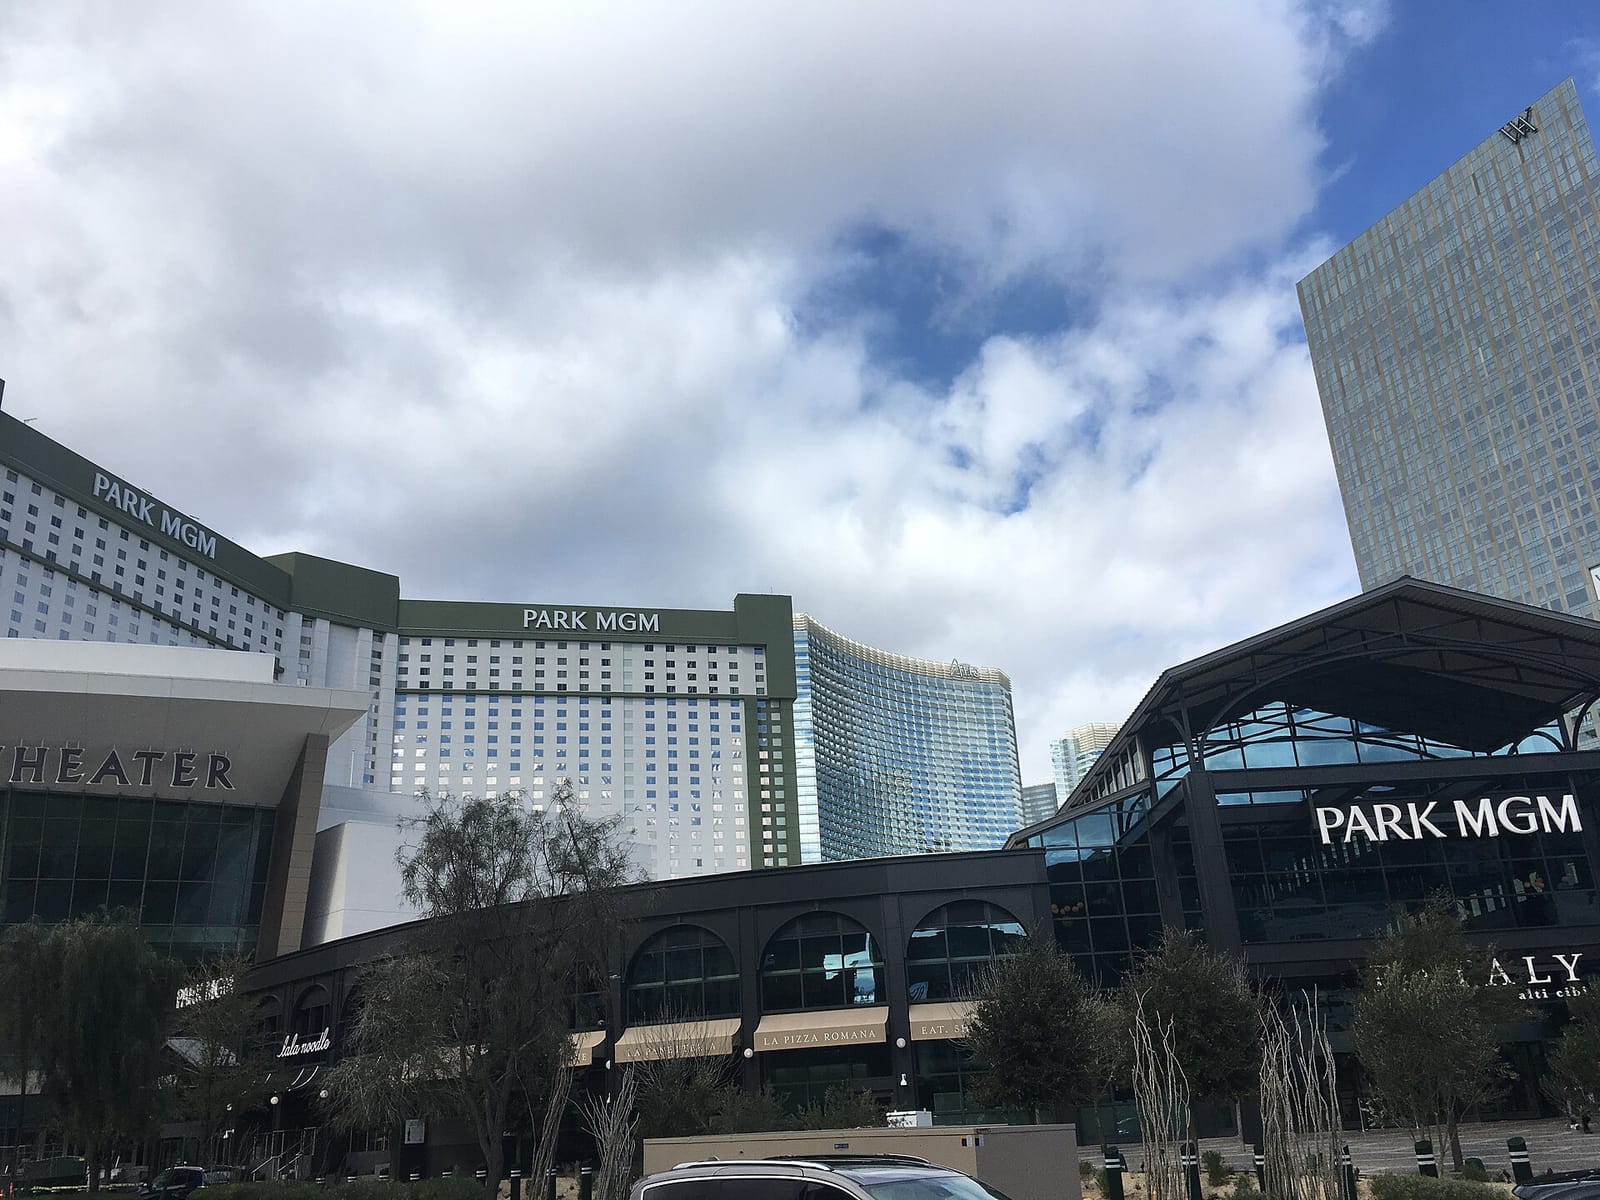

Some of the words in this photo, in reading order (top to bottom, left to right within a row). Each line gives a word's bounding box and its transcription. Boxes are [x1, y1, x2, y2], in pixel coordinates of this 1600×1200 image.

[93, 472, 155, 527] PARK
[160, 509, 217, 560] MGM
[523, 609, 588, 630] PARK
[595, 611, 660, 633] MGM
[0, 746, 235, 790] HEATER
[1316, 801, 1448, 845] PARK
[1453, 794, 1583, 838] MGM
[1518, 989, 1548, 1001] alti
[277, 1033, 300, 1058] lala
[301, 1027, 331, 1053] noodle
[763, 1037, 778, 1046] LA
[784, 1034, 819, 1044] PIZZA
[824, 1030, 877, 1041] ROMANA
[921, 1025, 950, 1035] EAT.
